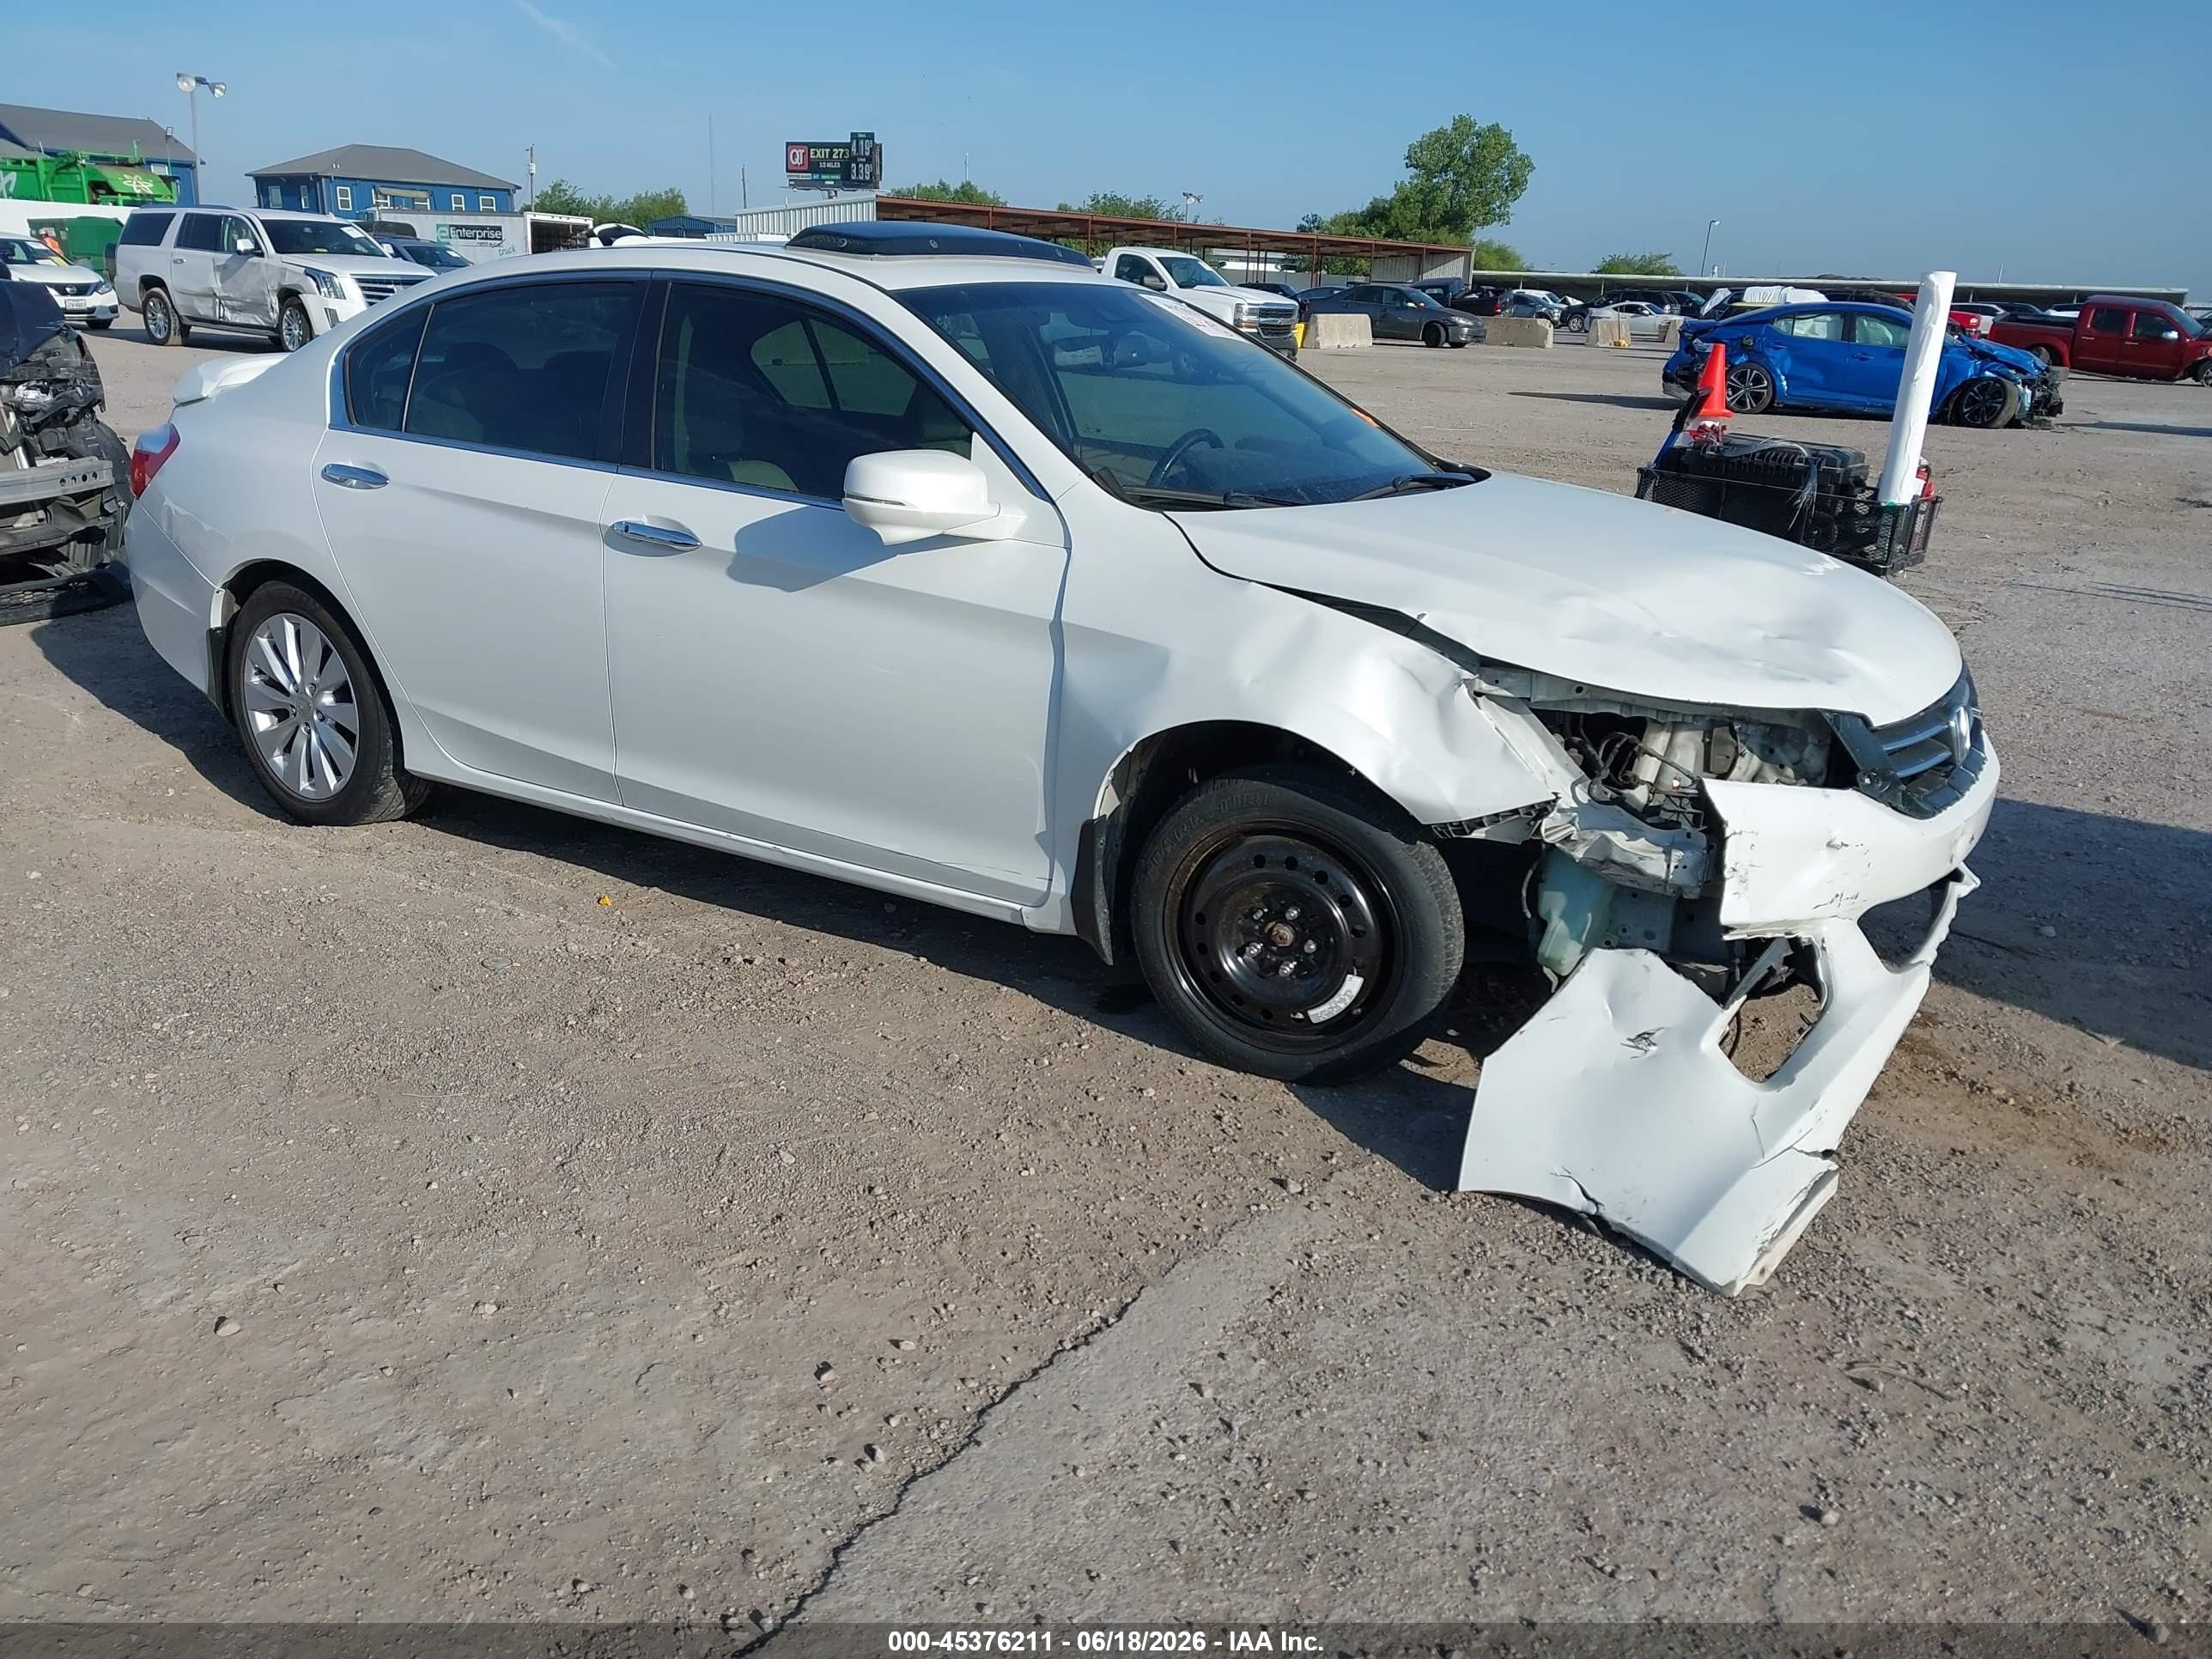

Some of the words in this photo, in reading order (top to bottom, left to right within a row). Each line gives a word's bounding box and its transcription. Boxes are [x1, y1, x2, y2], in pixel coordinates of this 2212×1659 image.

[789, 148, 805, 166] QT
[810, 148, 830, 159] EXIT
[832, 148, 850, 159] 273
[450, 227, 502, 240] Enterprise
[498, 246, 516, 257] truck
